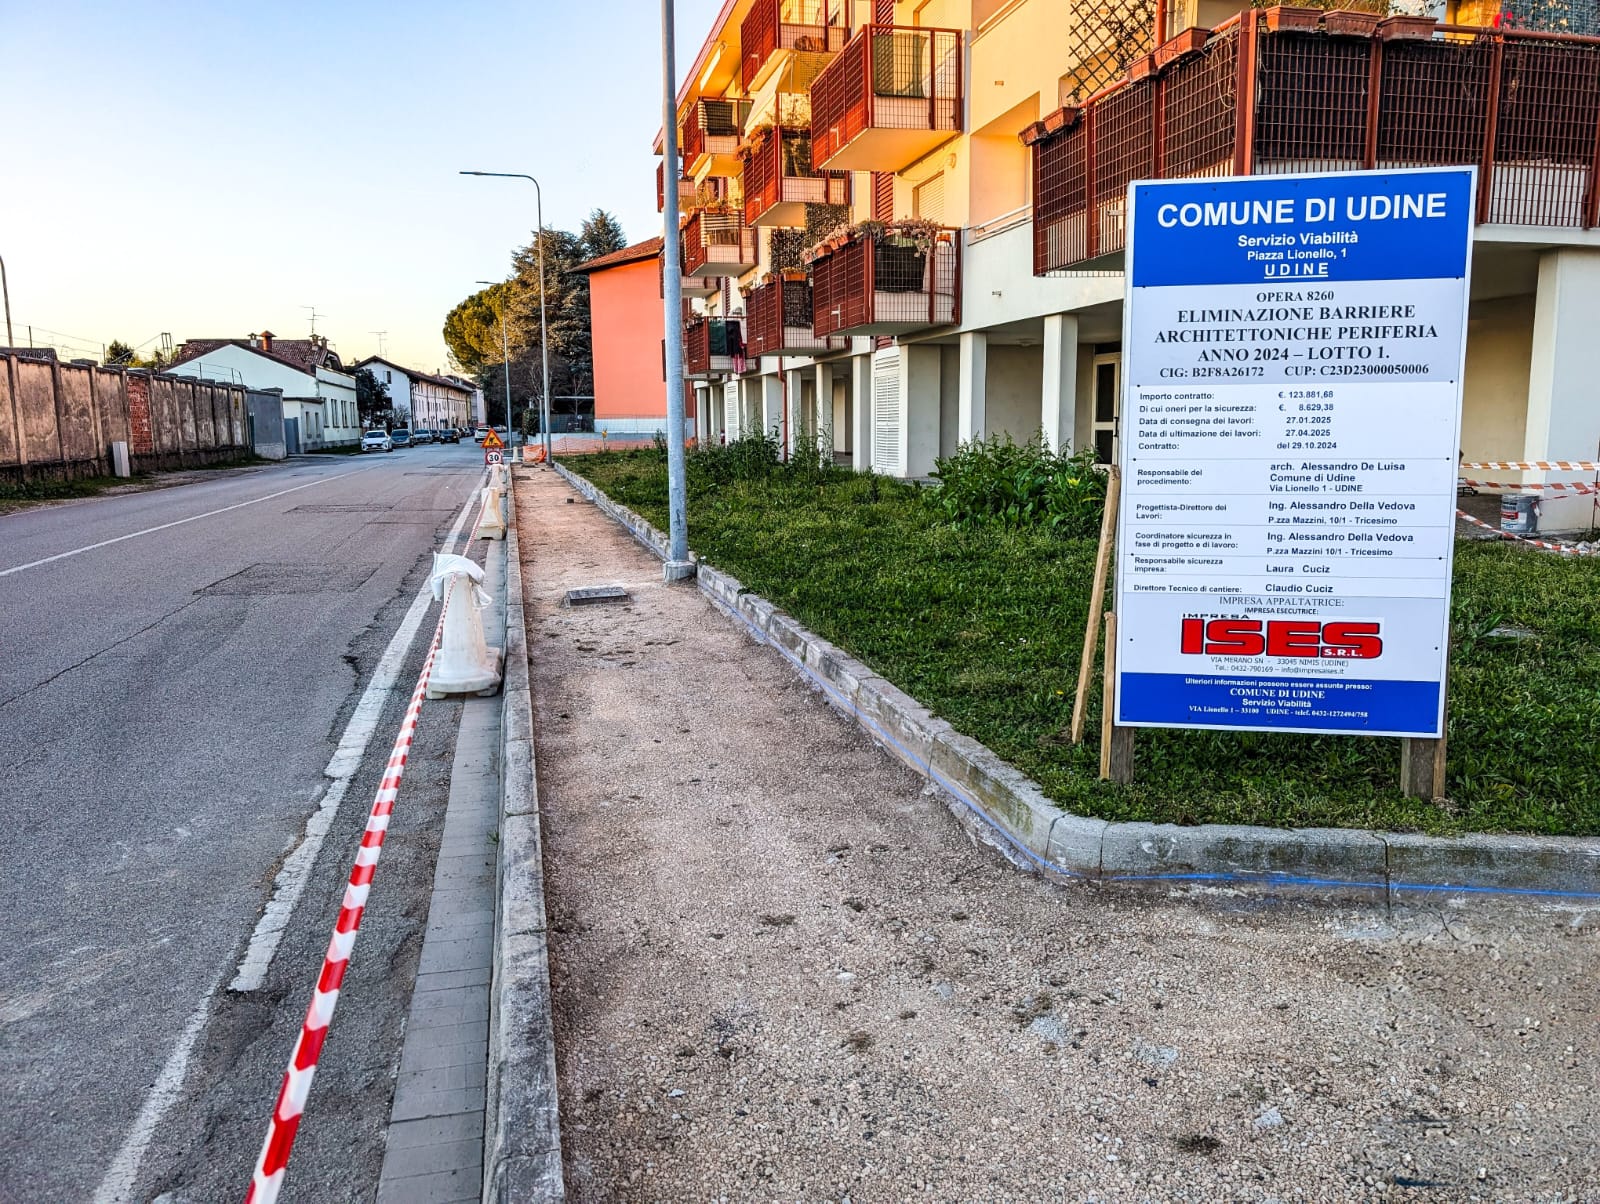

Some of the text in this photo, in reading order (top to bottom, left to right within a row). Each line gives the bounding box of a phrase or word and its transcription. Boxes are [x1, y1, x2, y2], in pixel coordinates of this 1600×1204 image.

[1157, 193, 1447, 228] COMUNE DI UDINE
[1238, 231, 1359, 247] Servizio Viabilità
[1247, 248, 1347, 260] Piazza Lionello, 1
[1256, 291, 1334, 302] OPERA 8260
[1178, 305, 1416, 323] ELIMINAZIONE BARRIERE
[1154, 324, 1438, 343] ARCHITETTONICHE PERIFERIA
[1197, 348, 1249, 362] ANNO
[1254, 348, 1289, 361] 2024
[1308, 346, 1372, 360] LOTTO
[1378, 346, 1390, 359] 1.
[1160, 364, 1430, 378] CIG: B2F8A26172 CUP: C23D23000050006
[1140, 393, 1172, 401] Importo
[1288, 390, 1334, 399] 123.881,68
[1189, 405, 1203, 413] per
[1215, 404, 1257, 412] sicurezza:
[1298, 404, 1334, 412] 8.629,38
[1170, 418, 1210, 426] consegna
[1286, 416, 1332, 424] 27.01.2025
[1139, 430, 1157, 438] Data
[1270, 462, 1405, 471] arch. Alessandro De Luisa
[1137, 469, 1188, 477] Responsabile
[1270, 473, 1356, 482] Comune di Udine
[1270, 484, 1283, 492] Via
[1286, 484, 1319, 492] Lionello
[1335, 484, 1363, 492] UDINE
[1269, 501, 1415, 511] Ing. Alessandro Della Vedova
[1267, 532, 1414, 542] Ing. Alessandro Della Vedova
[1351, 548, 1393, 556] Tricesimo
[1134, 557, 1223, 565] Responsabile sicurezza
[1266, 564, 1330, 573] Laura Cuciz
[1265, 584, 1333, 593] Claudio Cuciz
[1220, 597, 1345, 606] IMPRESA APPALTATRICE:
[1182, 620, 1383, 659] ISES
[1324, 648, 1363, 656] S.R.L.
[1230, 688, 1275, 697] COMUNE
[1293, 691, 1325, 699] UDINE
